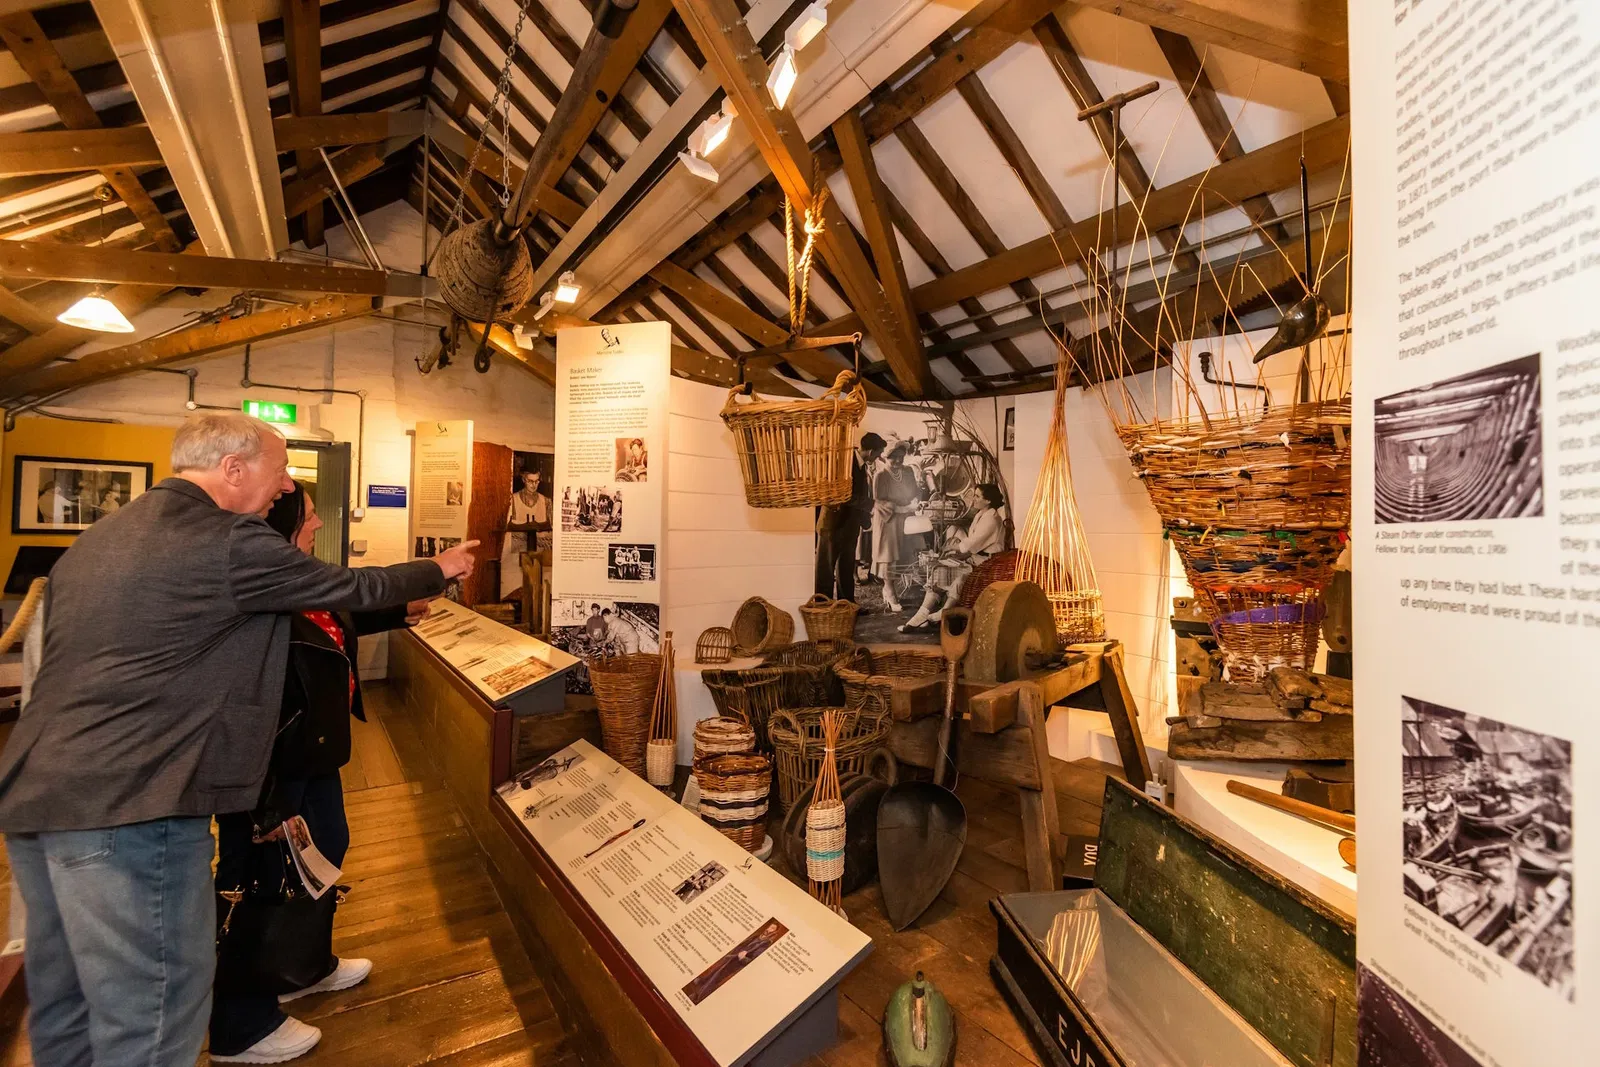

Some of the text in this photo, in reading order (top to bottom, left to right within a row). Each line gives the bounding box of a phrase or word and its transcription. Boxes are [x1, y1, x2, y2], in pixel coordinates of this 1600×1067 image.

[1397, 166, 1428, 194] century
[1398, 205, 1426, 230] fishing
[1426, 191, 1449, 214] from
[1450, 180, 1467, 199] the
[1398, 198, 1408, 213] In
[1398, 233, 1412, 250] the
[1399, 271, 1413, 286] The
[1415, 246, 1458, 278] beginning
[1459, 238, 1471, 256] of
[1473, 231, 1491, 249] the
[1520, 192, 1569, 226] century
[1453, 262, 1464, 281] of
[1465, 241, 1515, 274] Yarmouth
[1517, 203, 1597, 250] shipbuilding
[1399, 308, 1415, 324] that
[1416, 287, 1460, 317] coincided
[1461, 276, 1485, 297] with
[1485, 270, 1505, 287] the
[1506, 245, 1559, 277] fortunes
[1399, 322, 1427, 343] sailing
[1427, 307, 1469, 332] barques,
[1503, 273, 1549, 302] drifters
[1552, 260, 1578, 284] and
[1399, 314, 1498, 362] throughout the world.
[1375, 545, 1398, 554] Fellows
[1417, 545, 1437, 554] Great
[1381, 531, 1400, 539] Steam
[1401, 530, 1423, 539] Drifter
[1424, 530, 1444, 539] under
[1400, 578, 1411, 589] up
[1413, 578, 1429, 591] any
[1431, 577, 1451, 591] time
[1454, 578, 1476, 595] they
[1478, 580, 1499, 595] had
[1529, 582, 1565, 600] These
[1400, 595, 1410, 608] of
[1411, 597, 1467, 614] employment
[1469, 602, 1489, 616] and
[1492, 605, 1521, 620] were
[1524, 608, 1561, 624] proud
[1564, 610, 1578, 625] of
